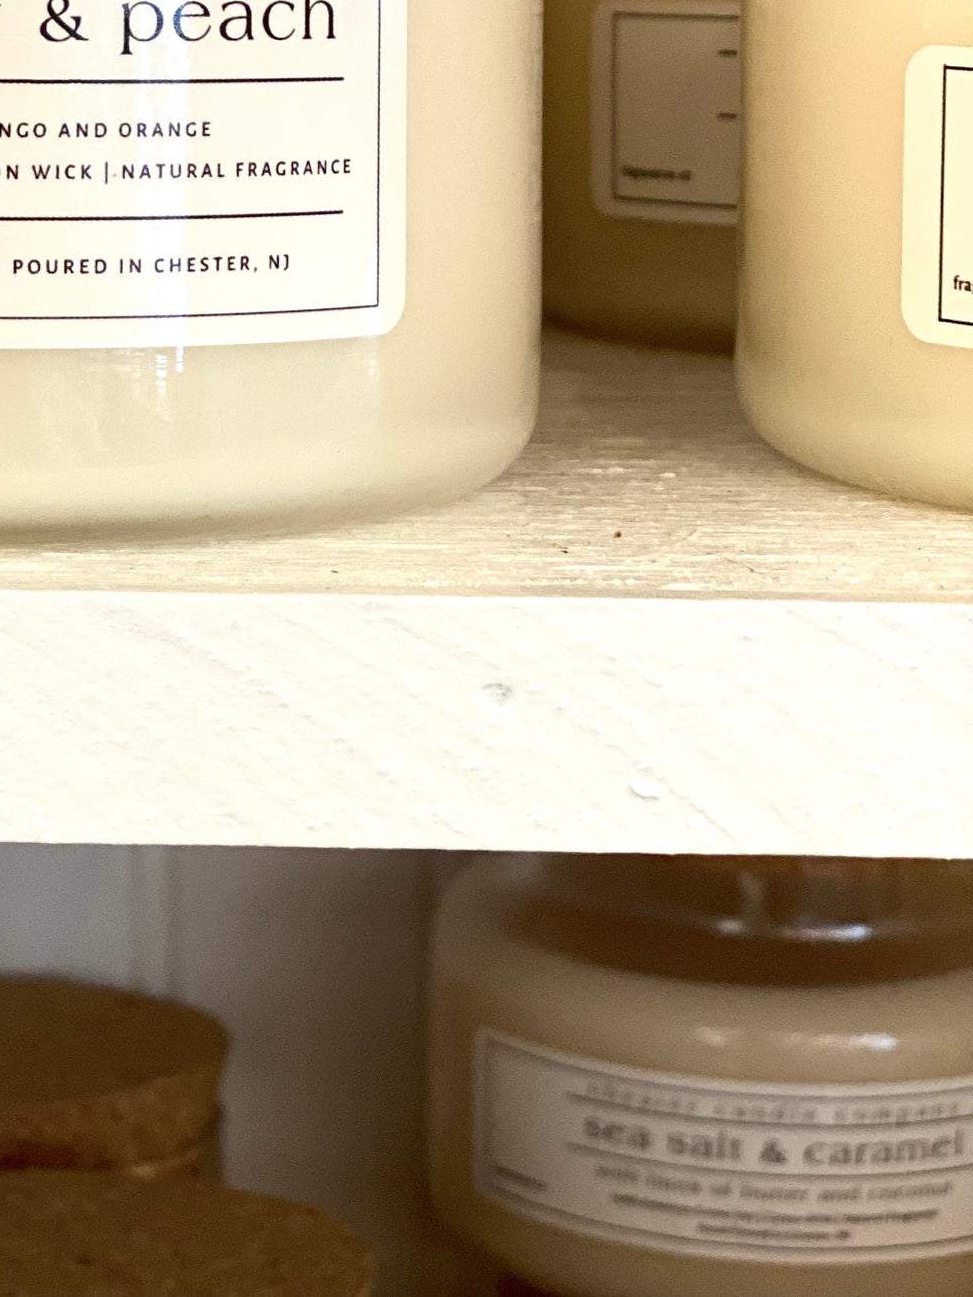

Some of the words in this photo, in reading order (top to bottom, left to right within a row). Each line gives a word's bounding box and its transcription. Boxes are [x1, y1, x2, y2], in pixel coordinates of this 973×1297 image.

[57, 121, 108, 139] AND
[118, 120, 212, 139] ORANGE
[30, 163, 93, 181] WICK
[121, 162, 226, 180] NATURAL
[235, 158, 352, 178] FRAGRANCE
[12, 258, 108, 275] POURED
[119, 258, 142, 275] IN
[153, 255, 258, 274] CHESTER,
[268, 253, 290, 272] NJ
[953, 274, 973, 295] fra
[583, 1114, 651, 1151] sea
[666, 1129, 741, 1161] salt
[803, 1129, 964, 1166] caramel
